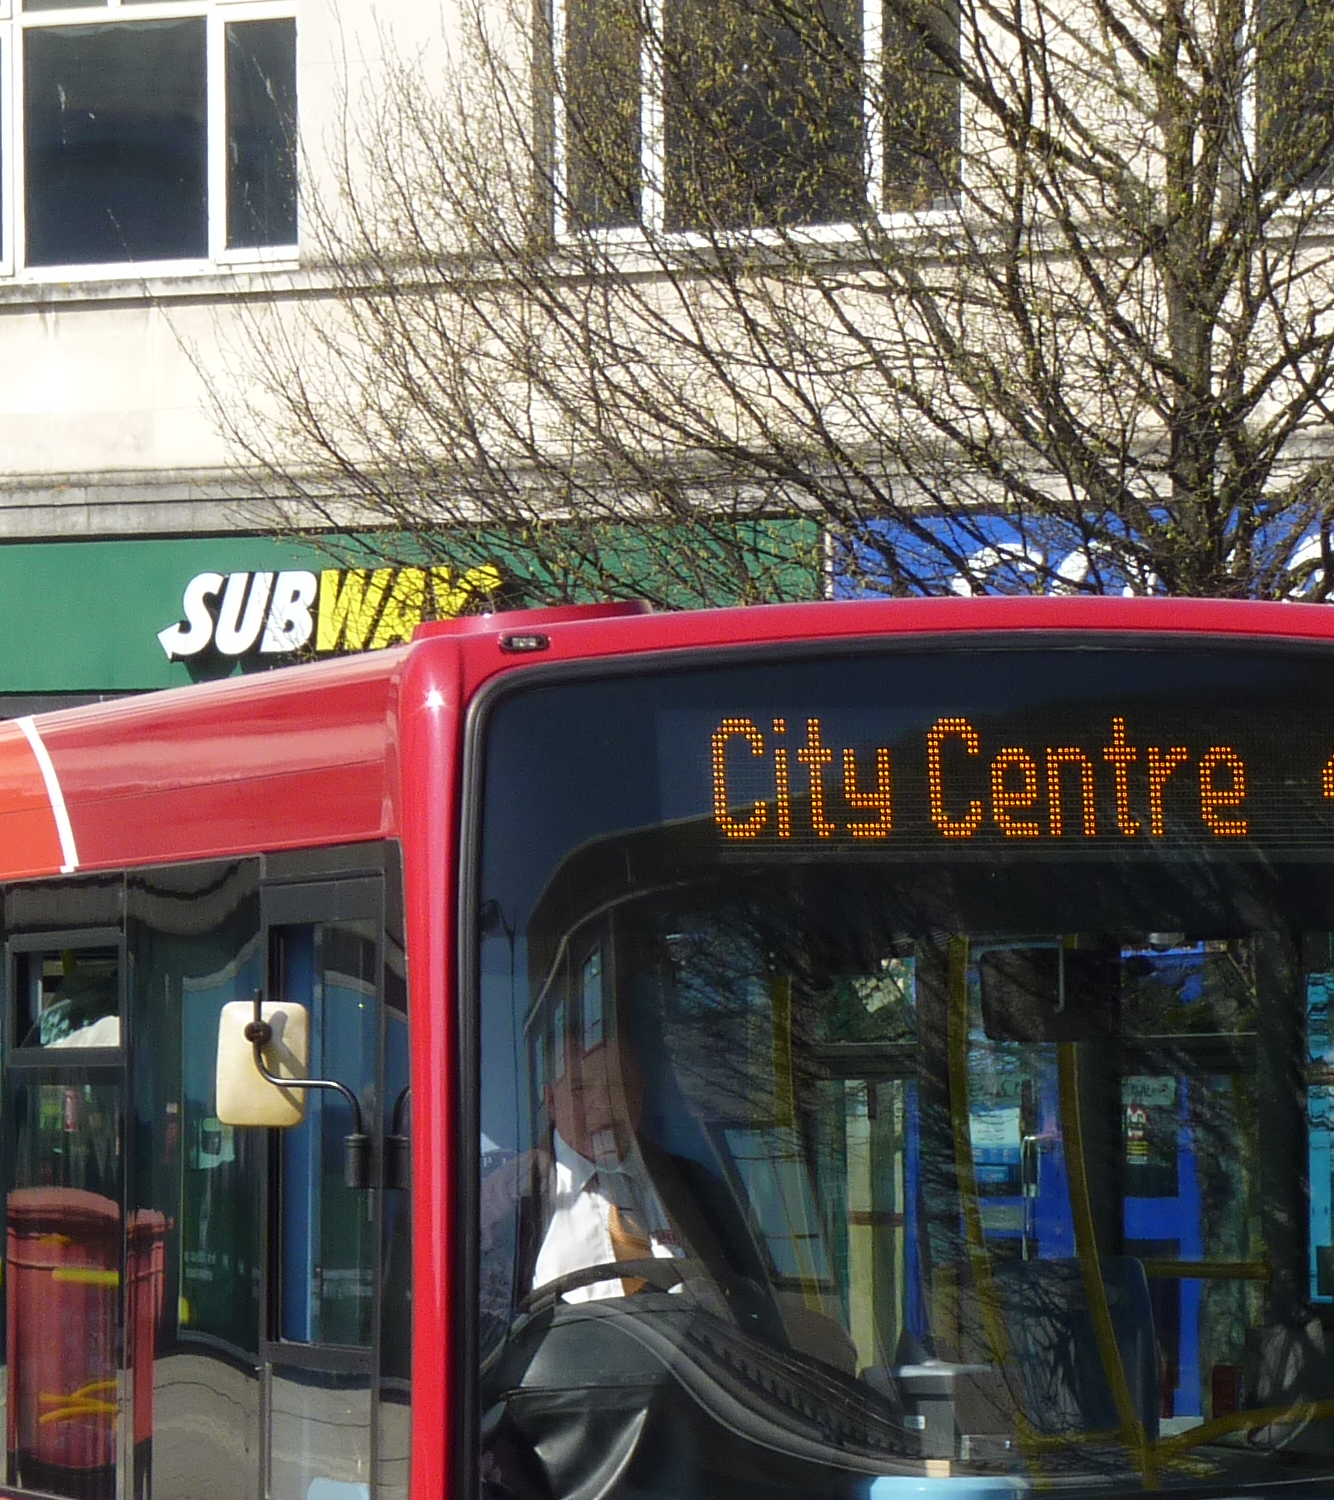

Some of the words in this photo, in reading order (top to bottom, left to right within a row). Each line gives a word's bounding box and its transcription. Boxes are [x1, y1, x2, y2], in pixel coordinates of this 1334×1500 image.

[157, 563, 503, 662] SUBWAY
[710, 716, 894, 838] City
[925, 716, 1249, 838] Centre
